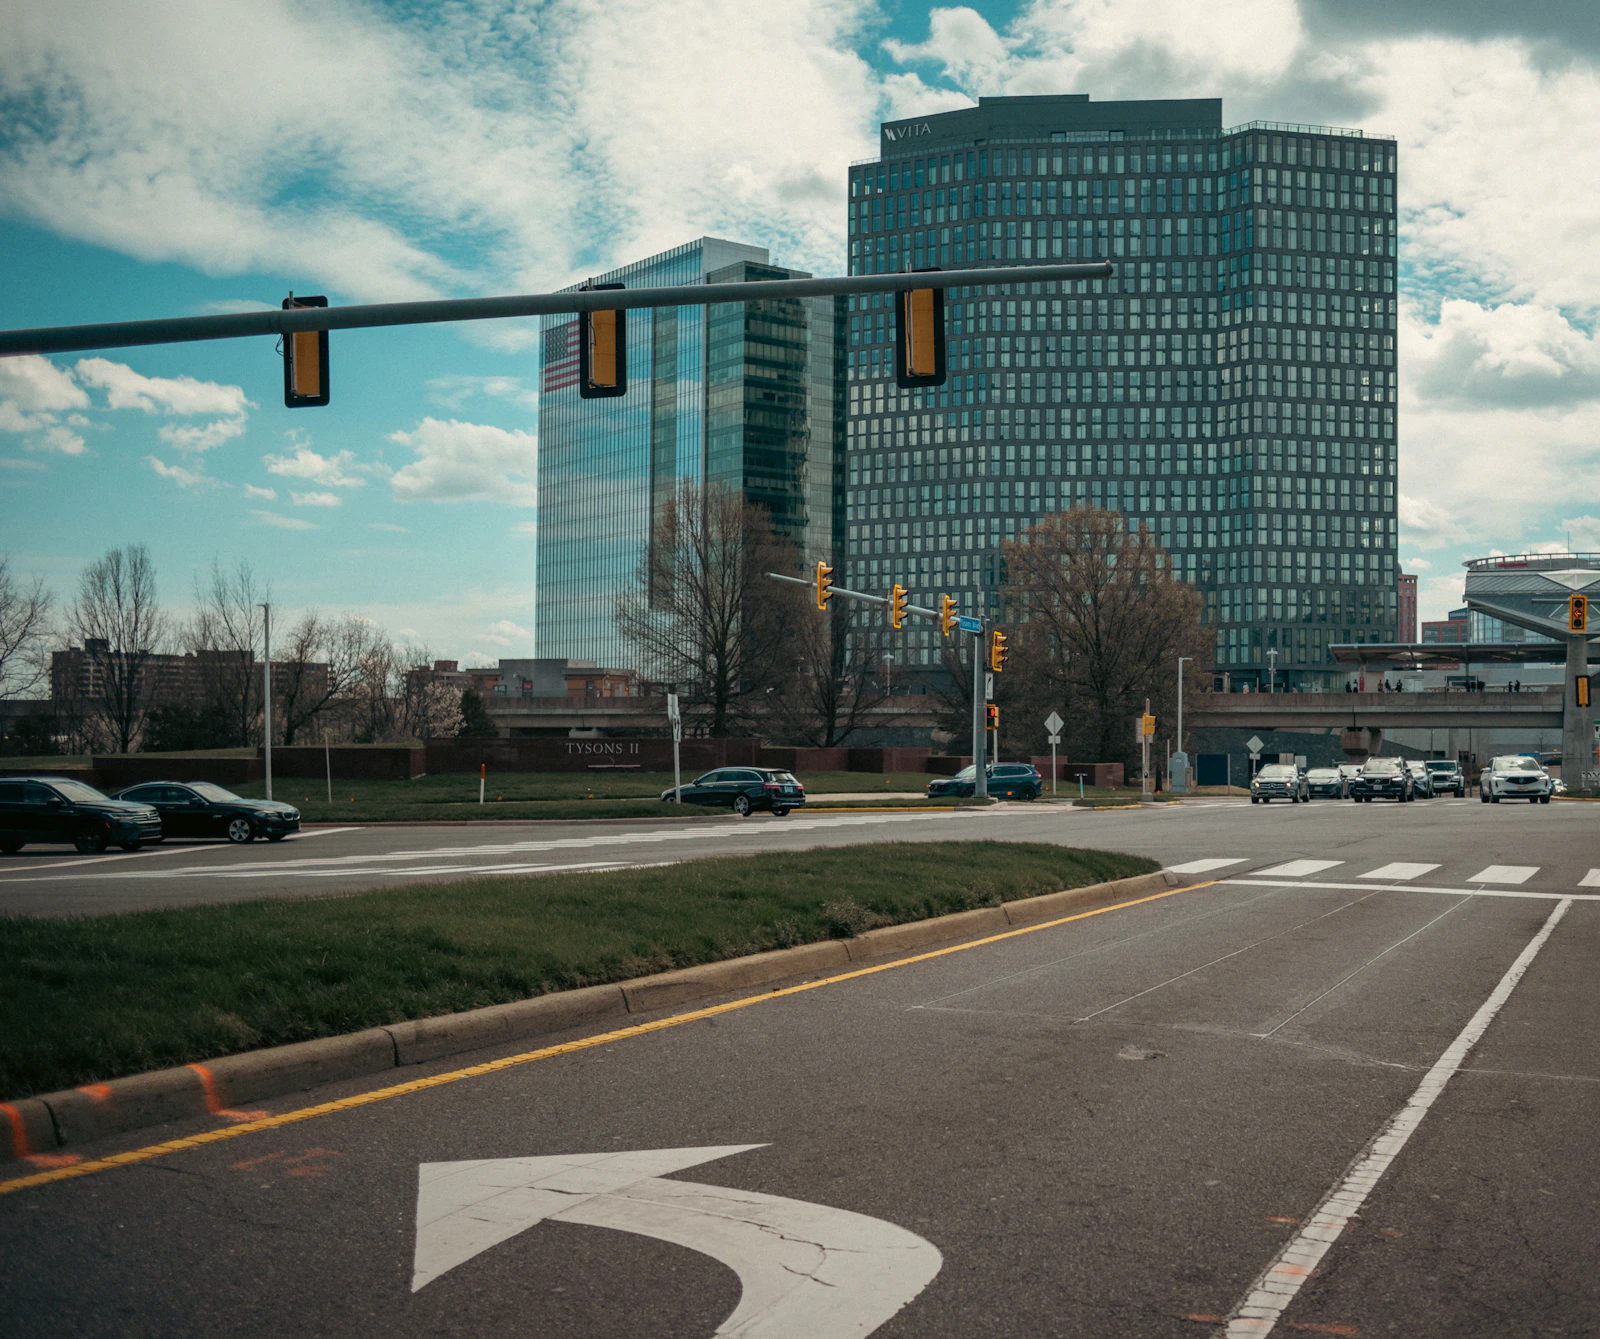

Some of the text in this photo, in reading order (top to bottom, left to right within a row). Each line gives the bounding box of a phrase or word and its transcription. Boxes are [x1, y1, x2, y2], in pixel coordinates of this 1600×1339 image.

[896, 123, 932, 139] VITA
[565, 742, 639, 754] TYSONS II
